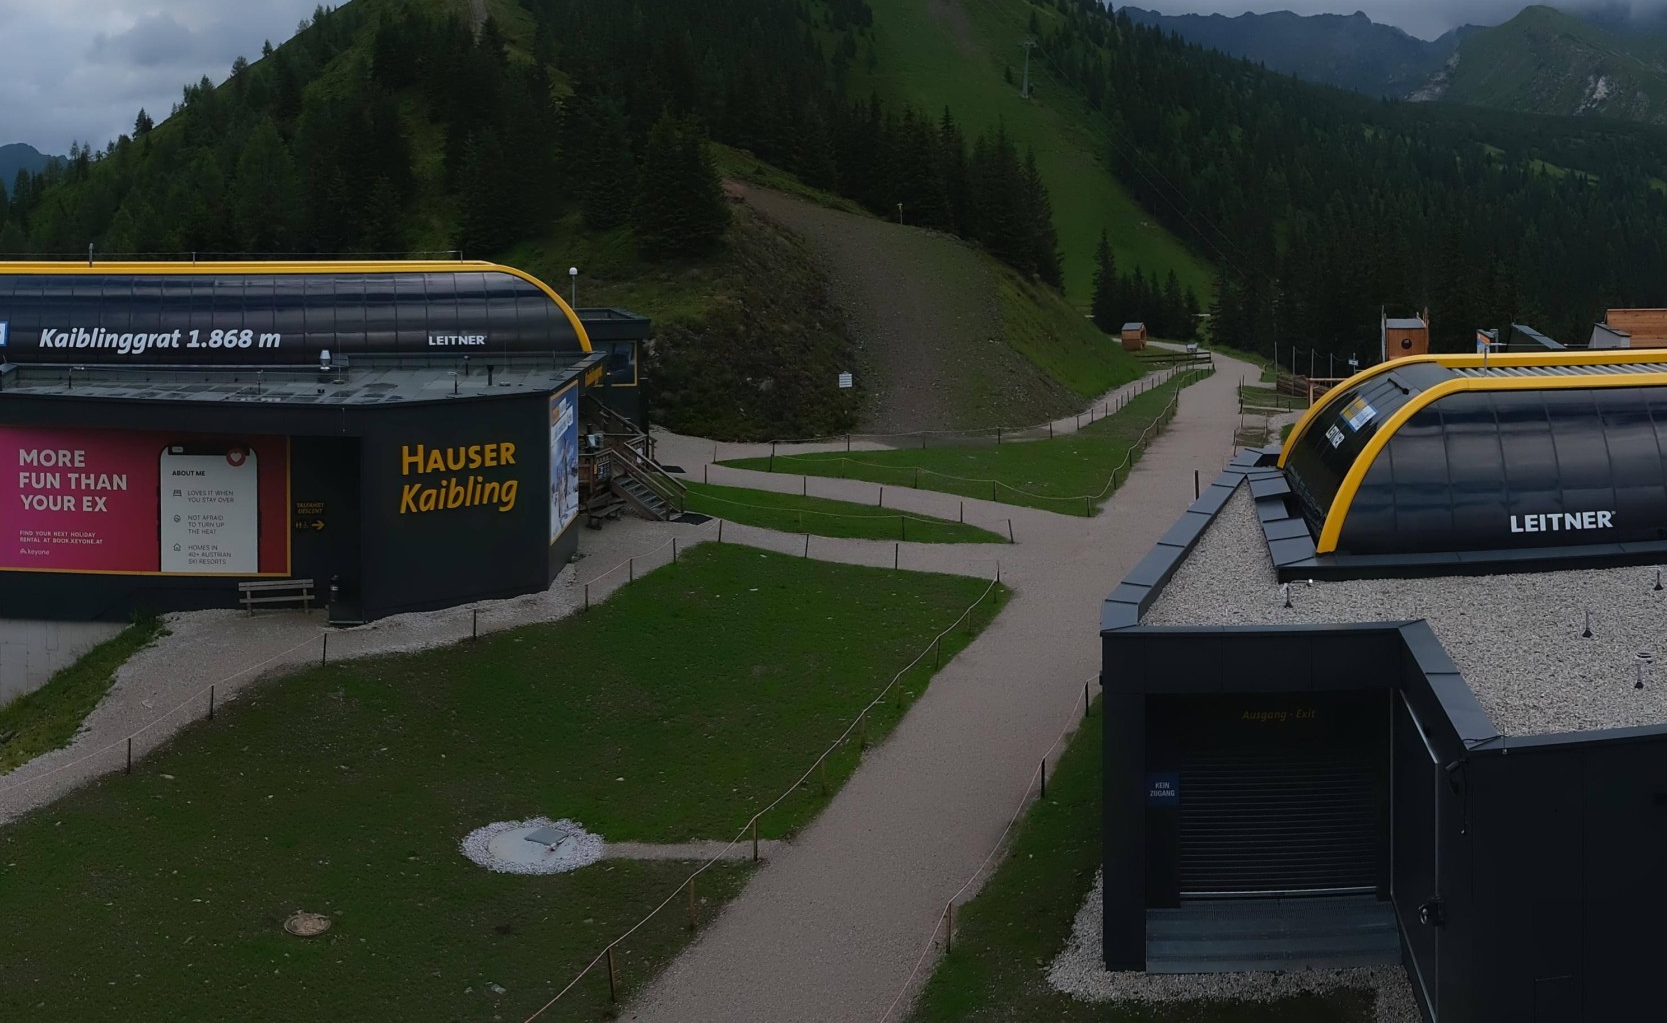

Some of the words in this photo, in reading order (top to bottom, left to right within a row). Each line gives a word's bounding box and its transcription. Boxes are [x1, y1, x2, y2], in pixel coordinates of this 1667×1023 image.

[39, 328, 182, 355] Kaiblinggrat
[186, 329, 254, 348] 1.868
[258, 333, 281, 348] m
[428, 335, 486, 346] LEITNER
[19, 448, 86, 468] MORE
[401, 442, 517, 476] HAUSER
[19, 472, 61, 490] FUN
[67, 473, 127, 491] THAN
[20, 495, 76, 512] YOUR
[82, 496, 108, 513] EX
[399, 476, 519, 514] Kaibling
[1510, 510, 1614, 534] LEITNER
[27, 548, 51, 557] keyone
[1240, 710, 1287, 722] Ausgang
[1295, 708, 1317, 719] Exit
[1149, 790, 1176, 798] ZUGANG
[1155, 781, 1170, 789] KEIN
